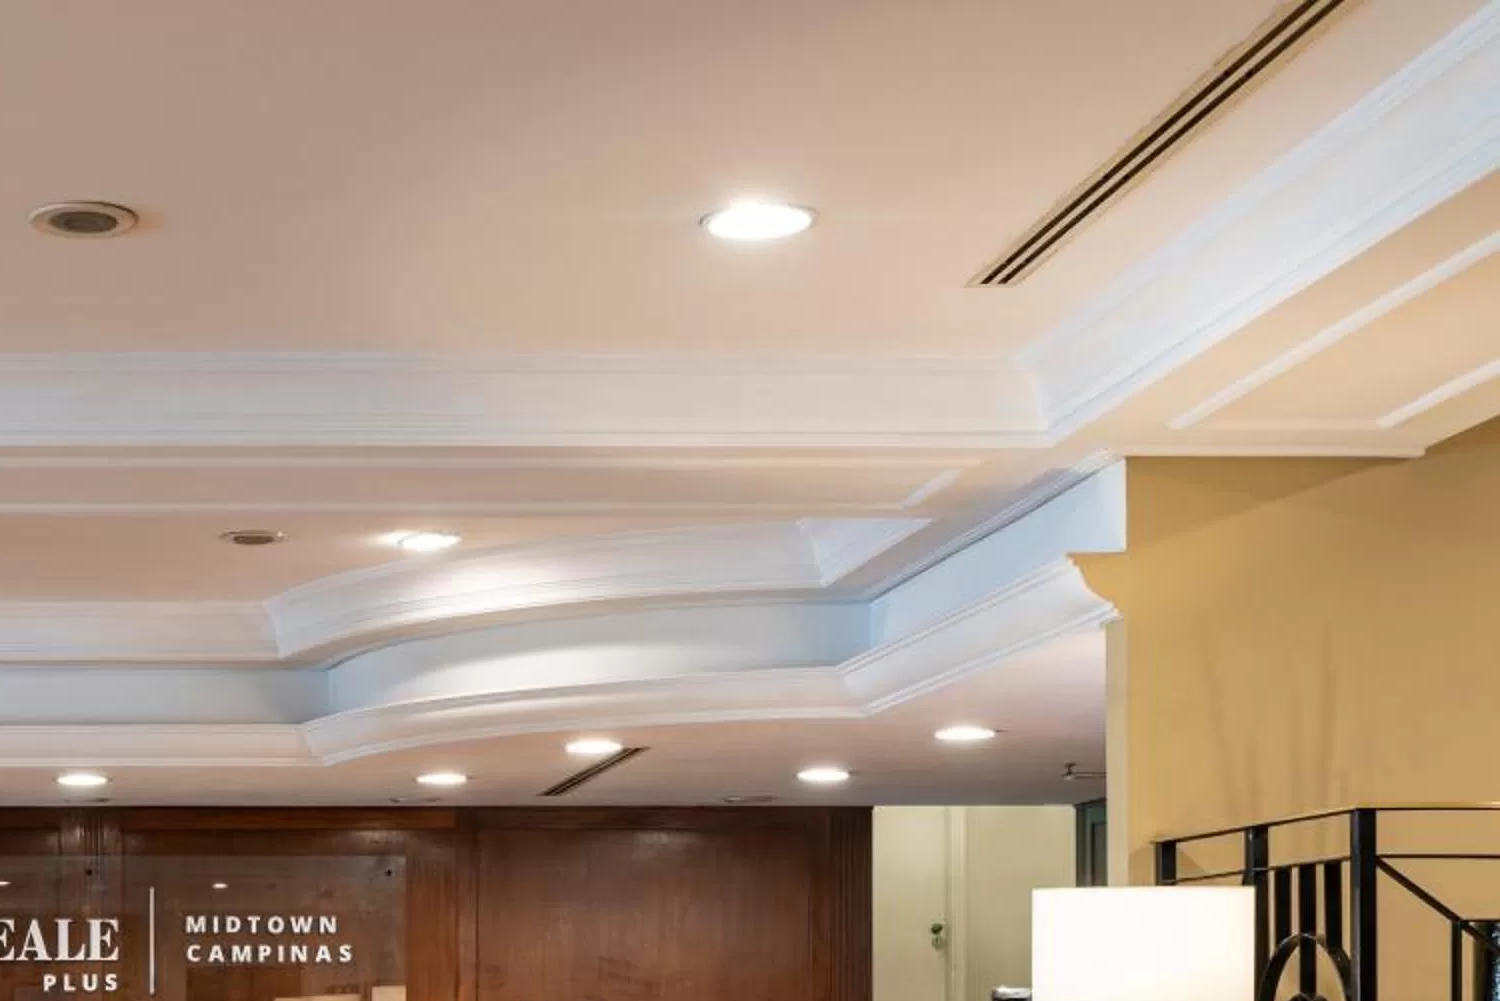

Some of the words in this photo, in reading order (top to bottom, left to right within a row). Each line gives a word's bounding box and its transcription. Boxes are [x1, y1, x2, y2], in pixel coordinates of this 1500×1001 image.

[186, 915, 338, 935] MIDTOWN
[186, 943, 353, 963] CAMPINAS
[43, 973, 118, 992] PLUS
